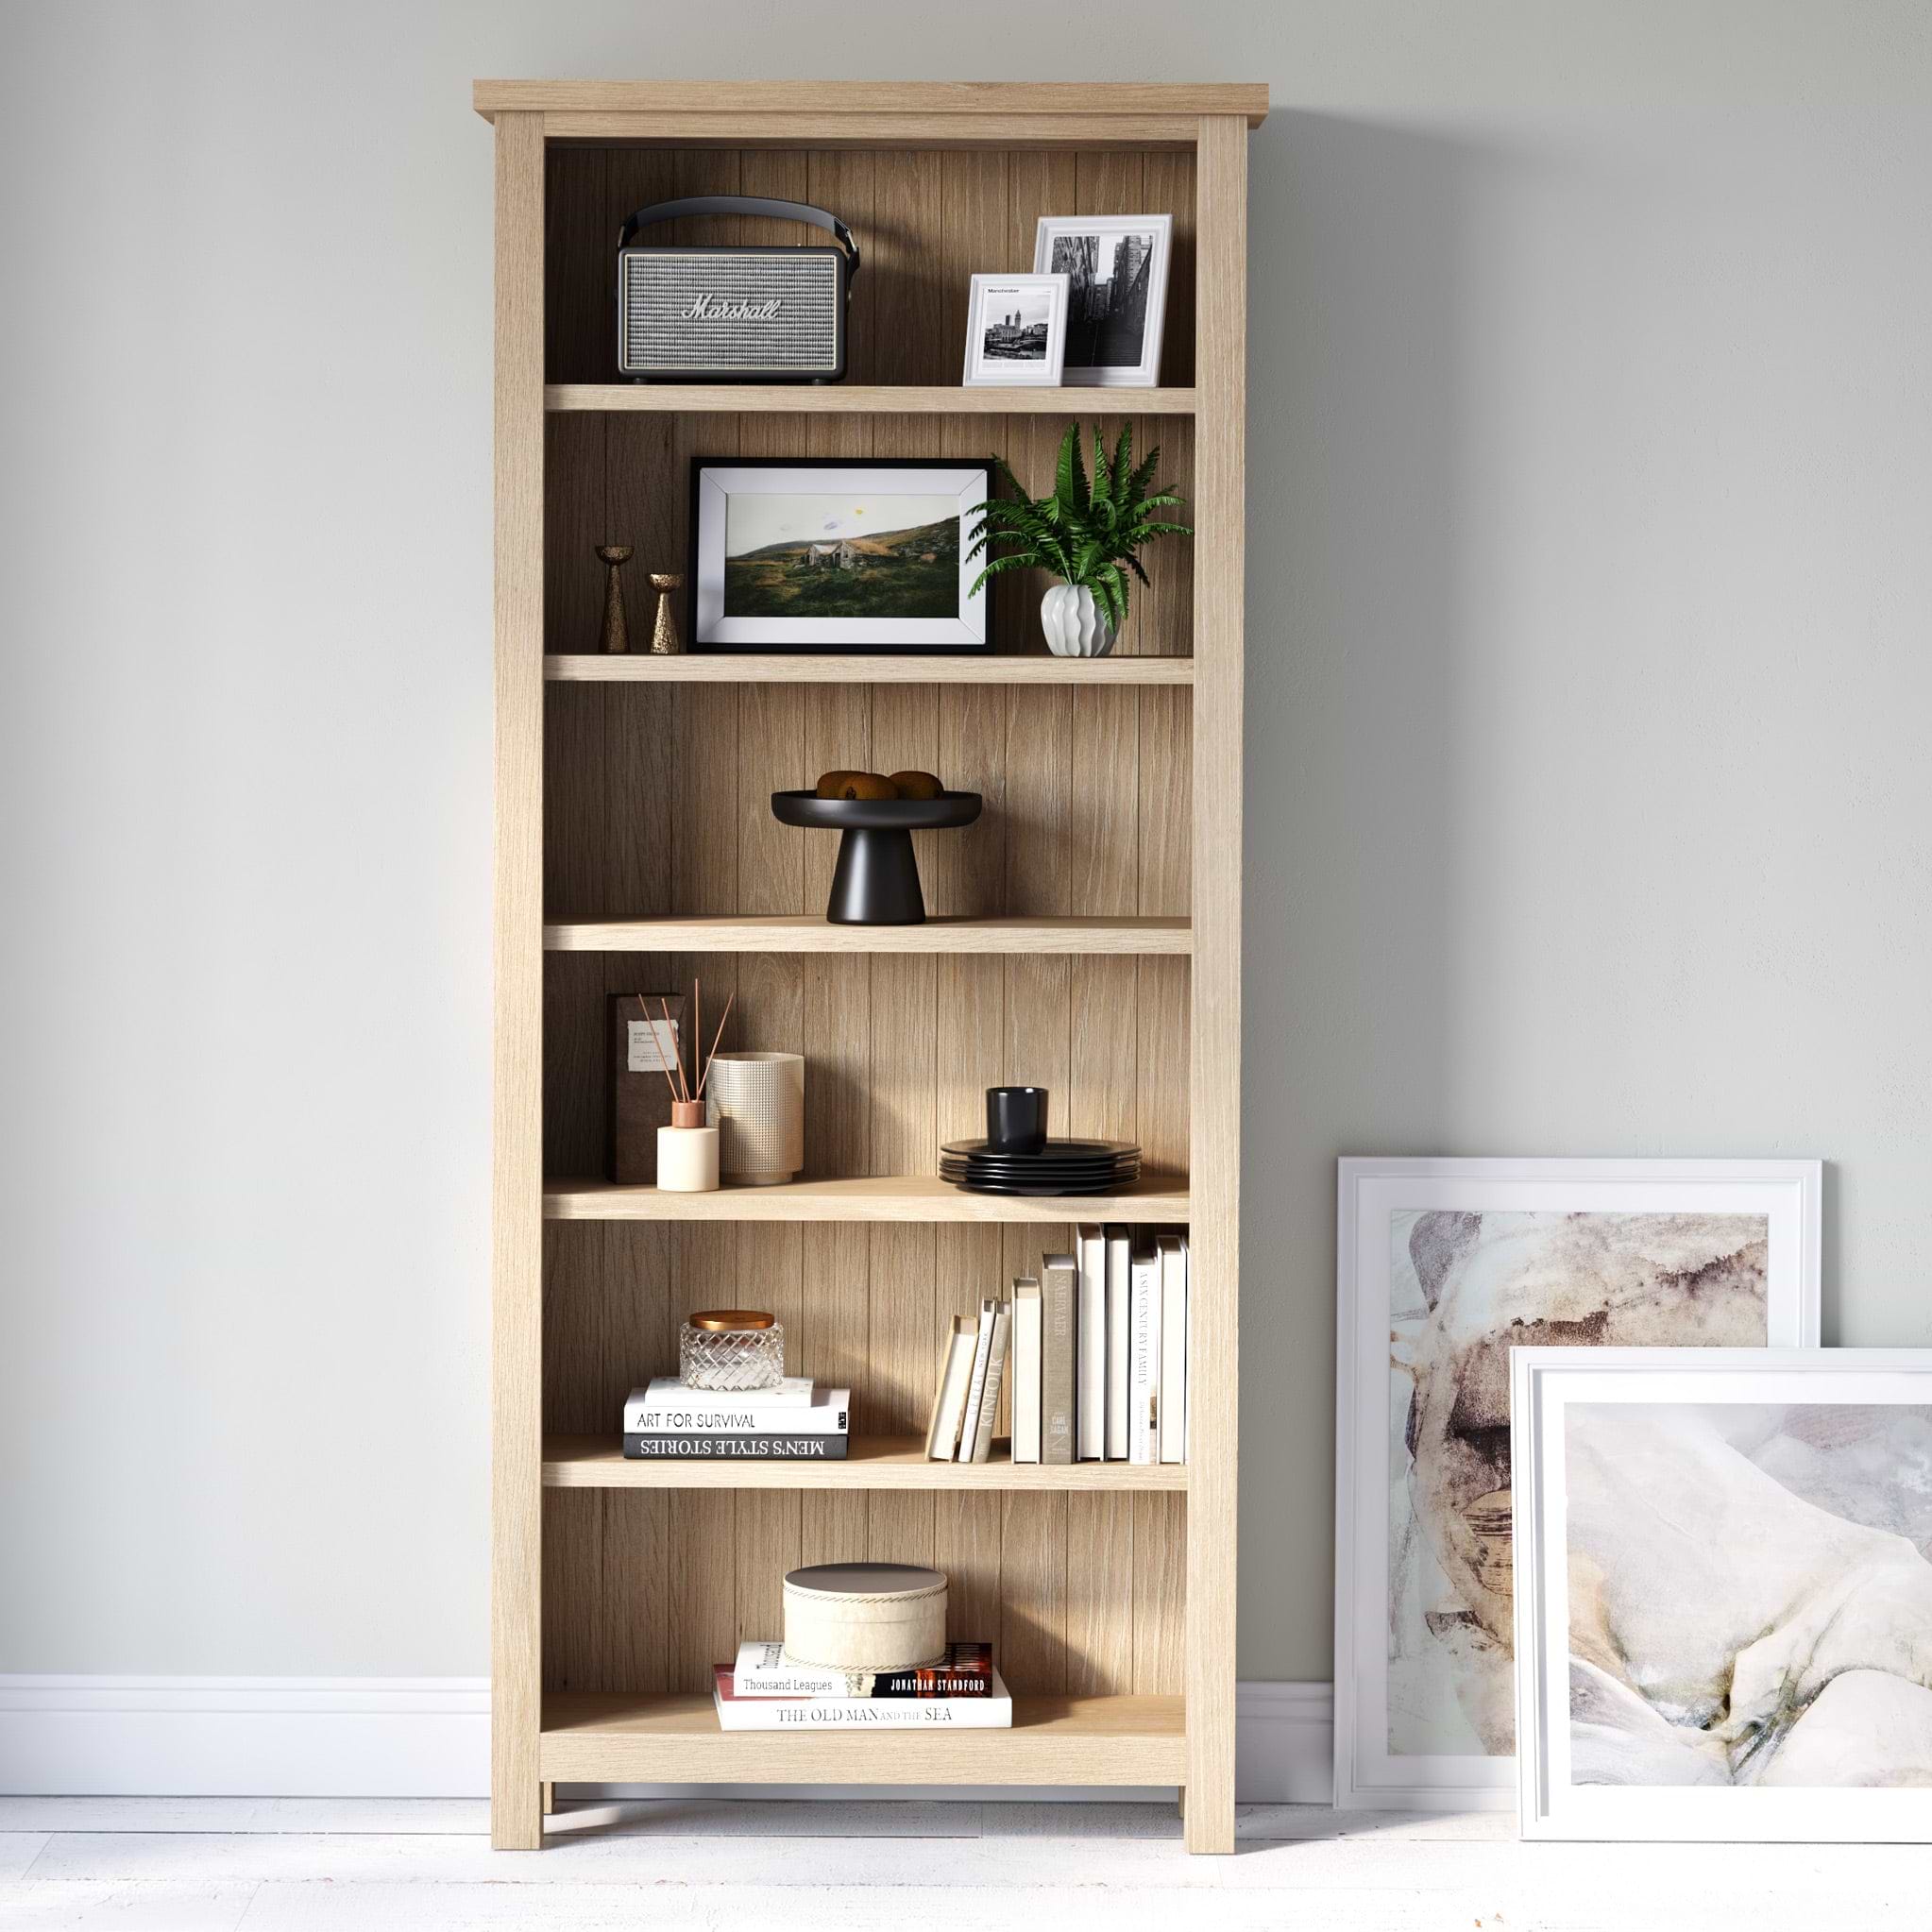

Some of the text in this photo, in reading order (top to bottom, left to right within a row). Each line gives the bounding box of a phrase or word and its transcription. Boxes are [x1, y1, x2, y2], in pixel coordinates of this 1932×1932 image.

[682, 294, 782, 319] Marshall
[1139, 1297, 1148, 1345] CENTURY
[1138, 1347, 1147, 1385] FAMILY
[980, 1358, 1003, 1427] KINFOLK
[636, 1414, 755, 1428] ART FOR SURVIVAL
[641, 1440, 825, 1455] MEN'S STYLE STORIES
[743, 1678, 833, 1692] Thousand Leagues
[890, 1678, 985, 1691] JONATHAN STANDFORD
[777, 1708, 807, 1722] THE
[810, 1708, 842, 1722] OLD
[846, 1707, 879, 1721] MAN
[880, 1710, 900, 1721] AND
[924, 1706, 953, 1721] SEA
